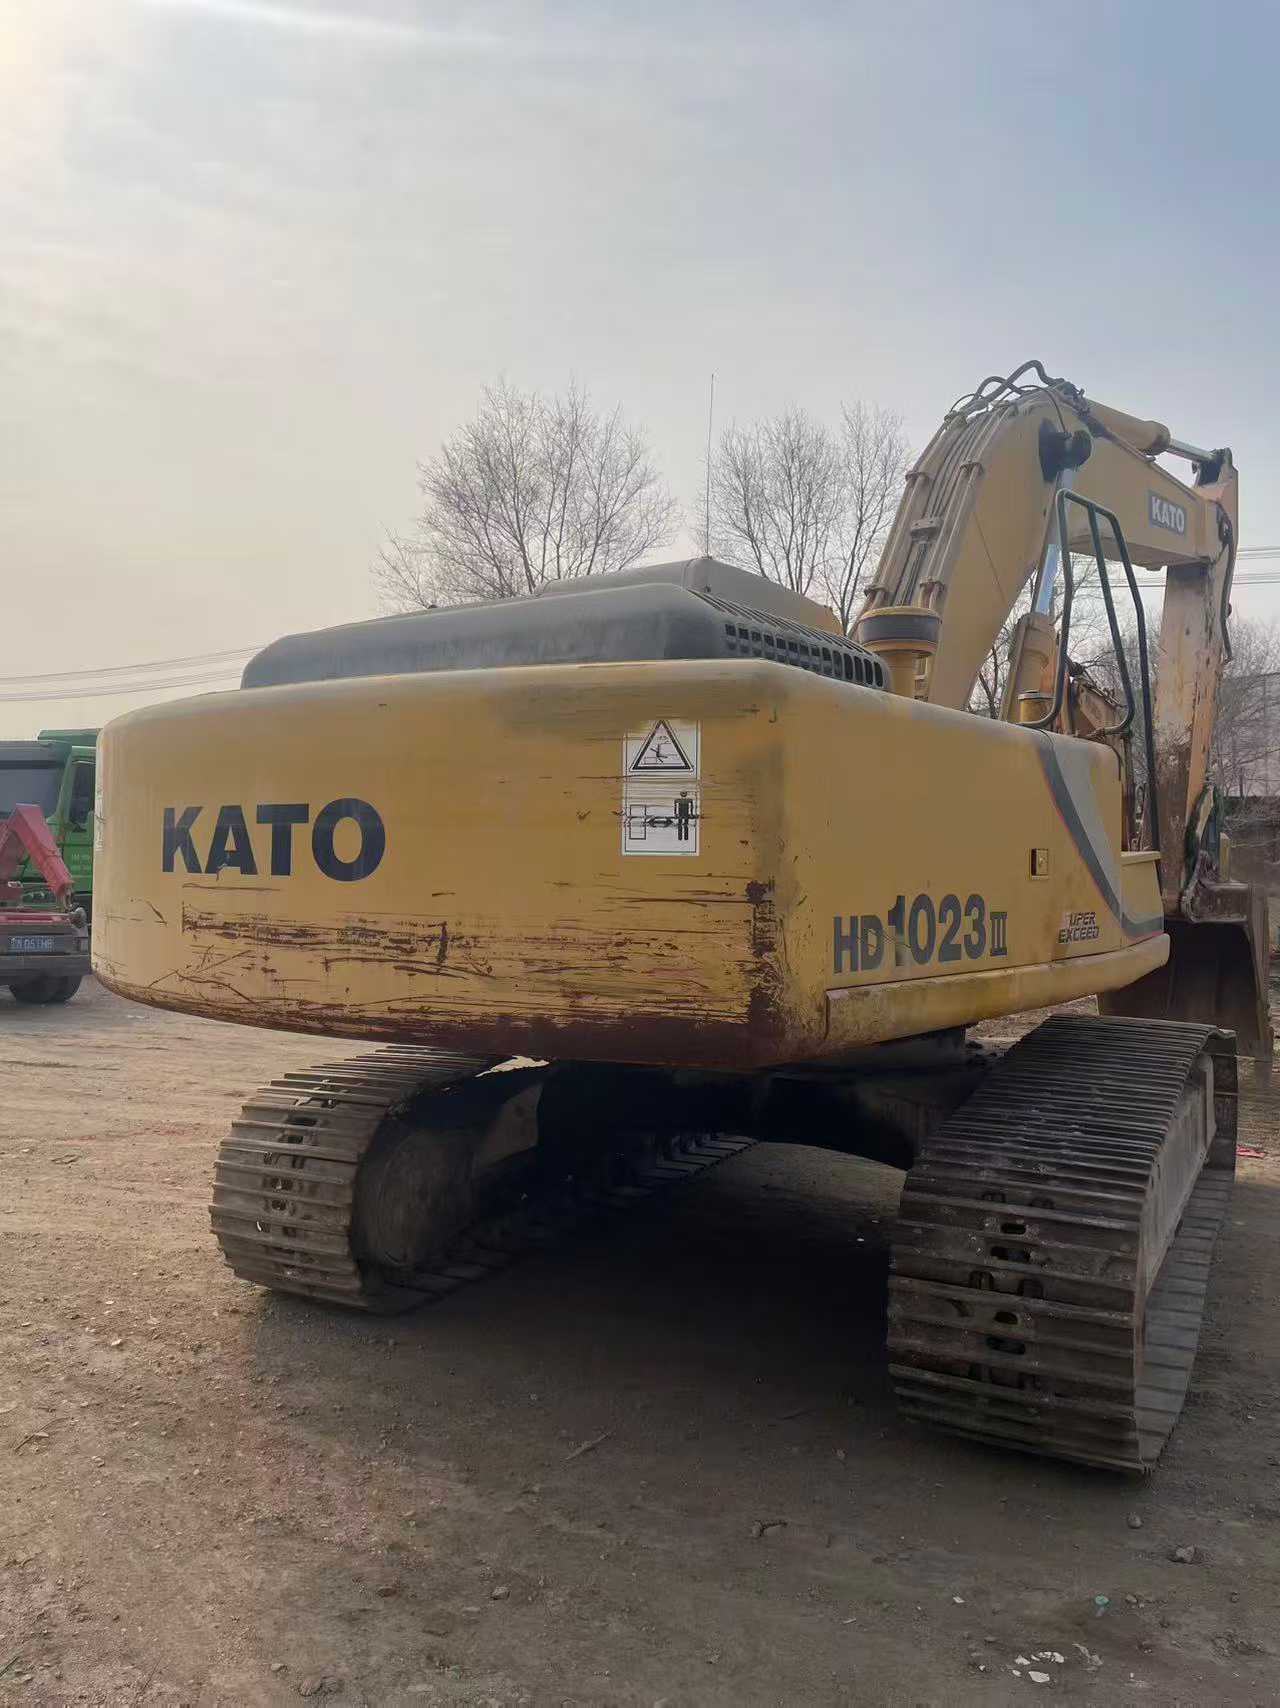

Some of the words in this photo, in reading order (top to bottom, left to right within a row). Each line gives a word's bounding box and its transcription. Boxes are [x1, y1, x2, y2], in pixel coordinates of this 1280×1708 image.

[1151, 496, 1186, 533] KATO
[161, 797, 386, 882] KATO
[1058, 926, 1100, 943] EXCEED
